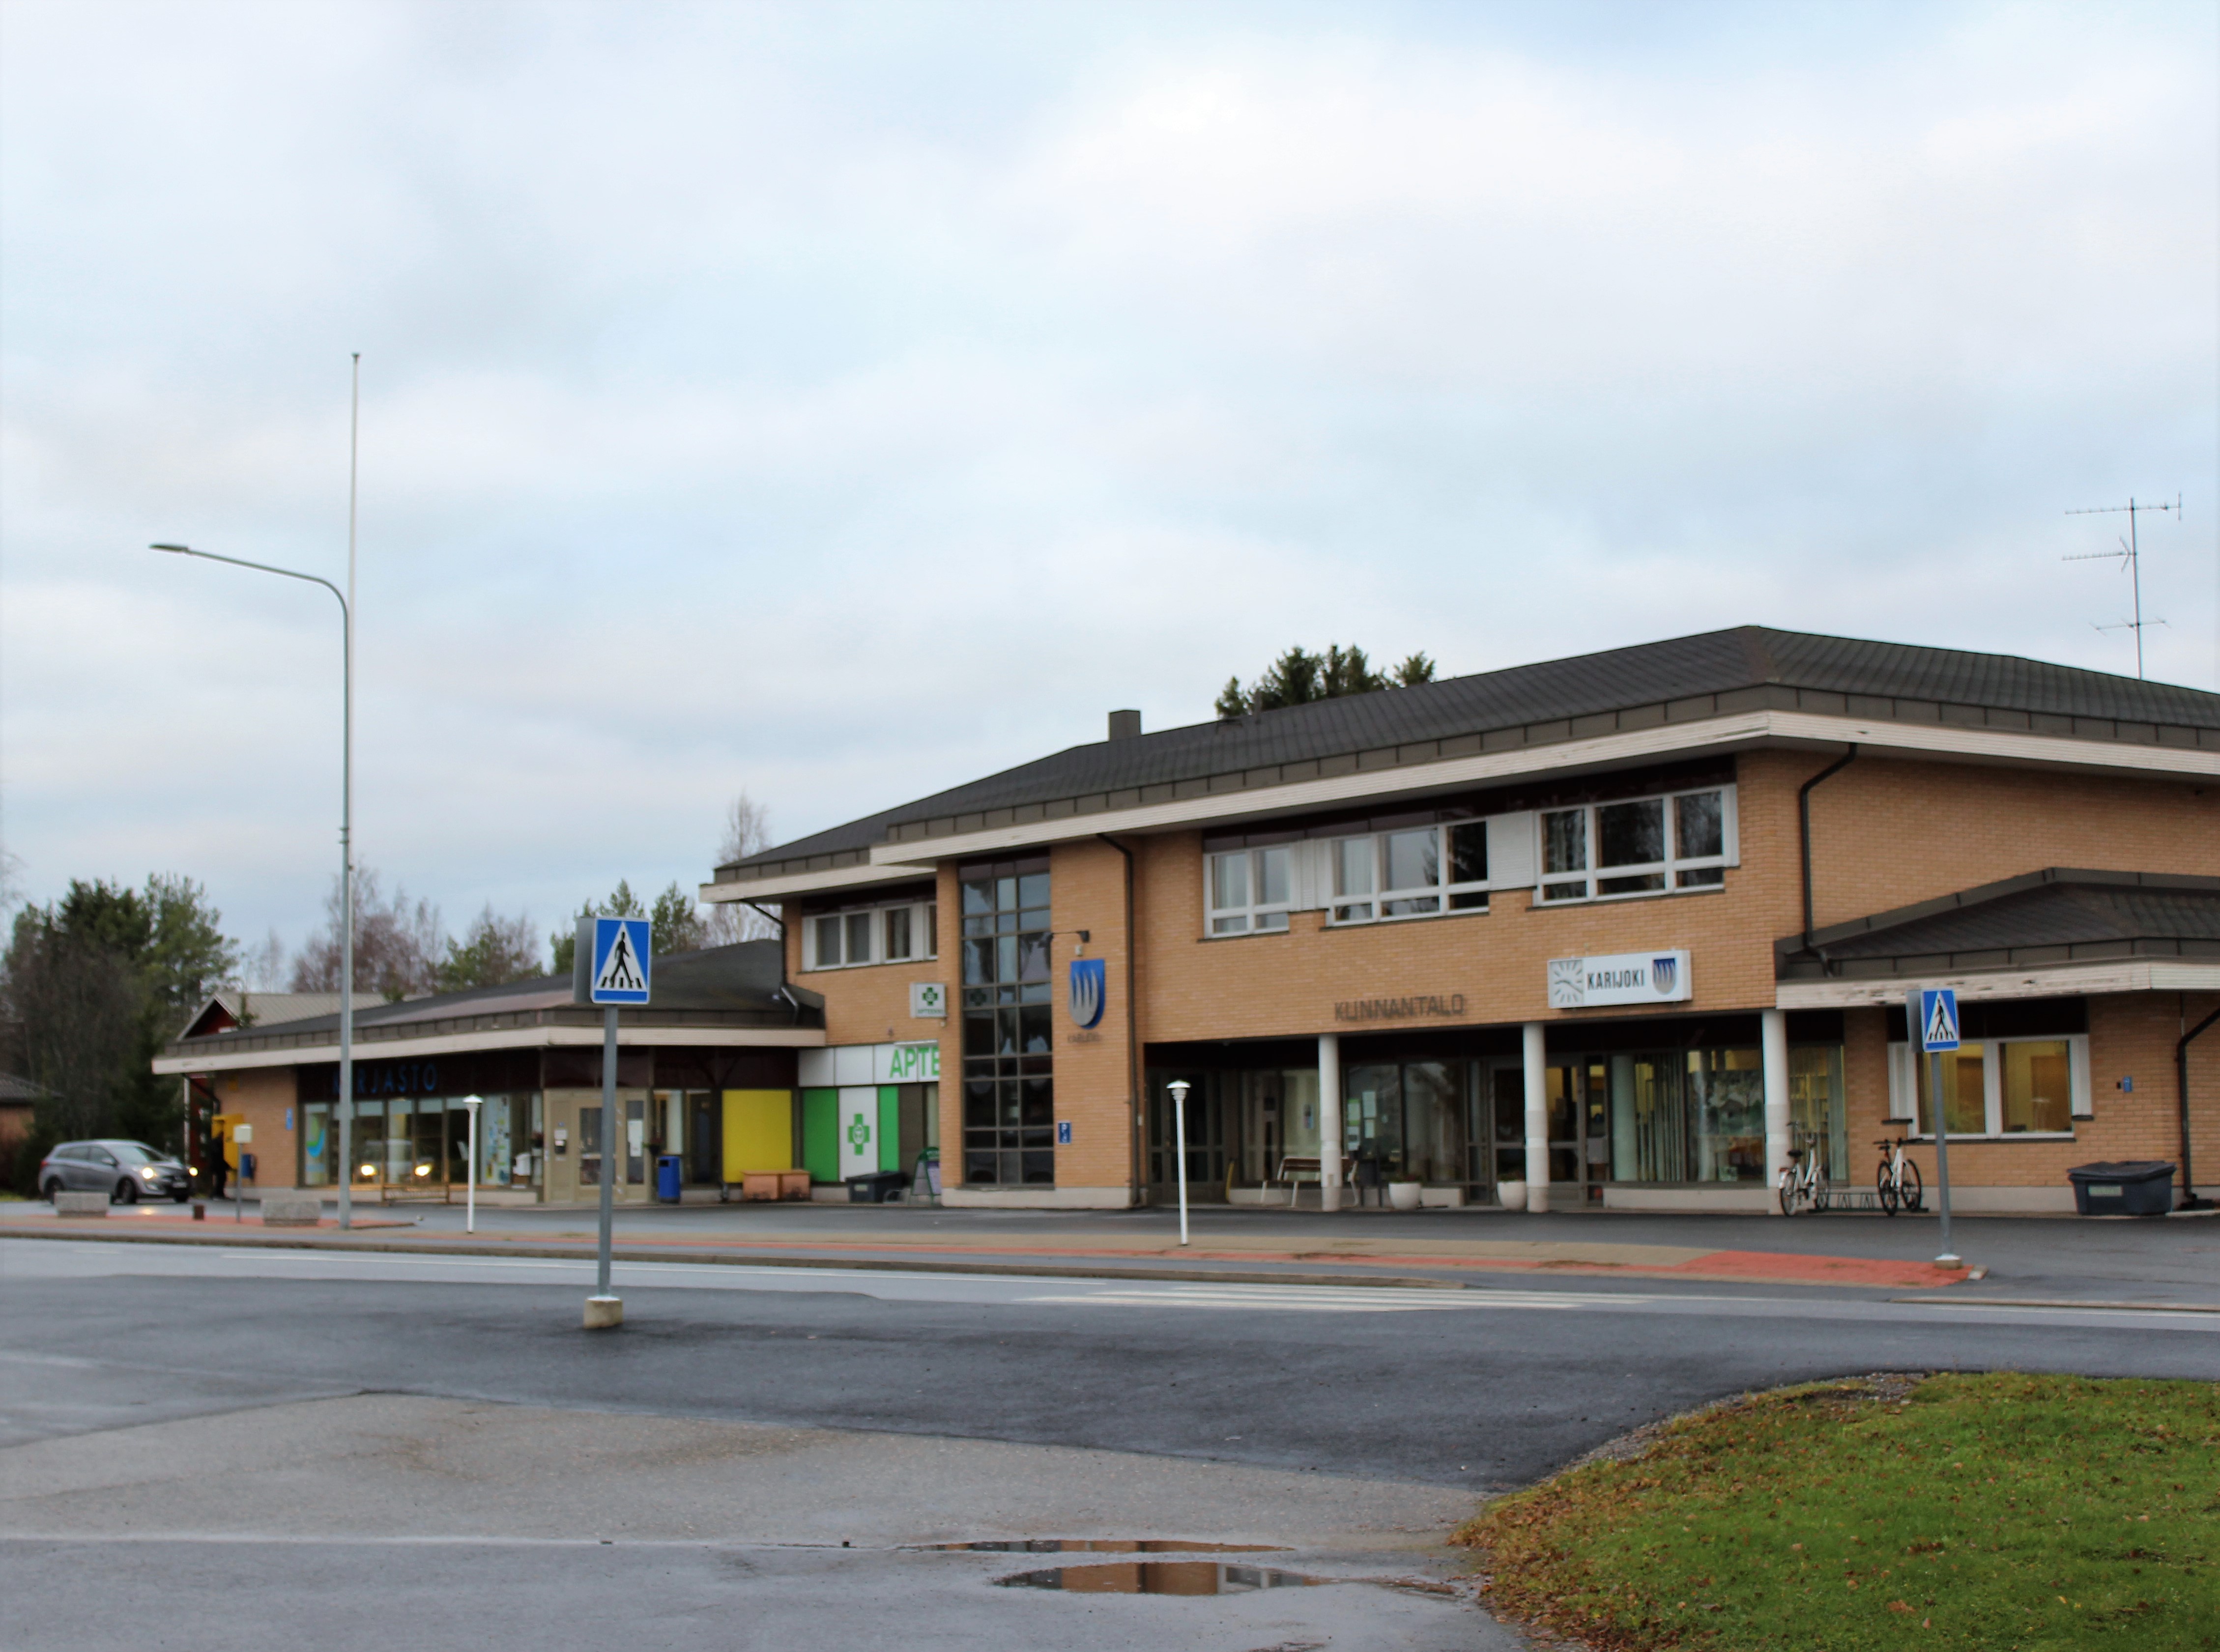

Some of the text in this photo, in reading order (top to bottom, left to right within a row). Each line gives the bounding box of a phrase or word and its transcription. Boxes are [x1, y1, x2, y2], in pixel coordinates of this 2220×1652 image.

[1586, 969, 1643, 990] KARIJOKI
[1335, 994, 1464, 1022] KUNNANTALO
[890, 1047, 939, 1078] APTE
[333, 1063, 437, 1094] KRJASTO
